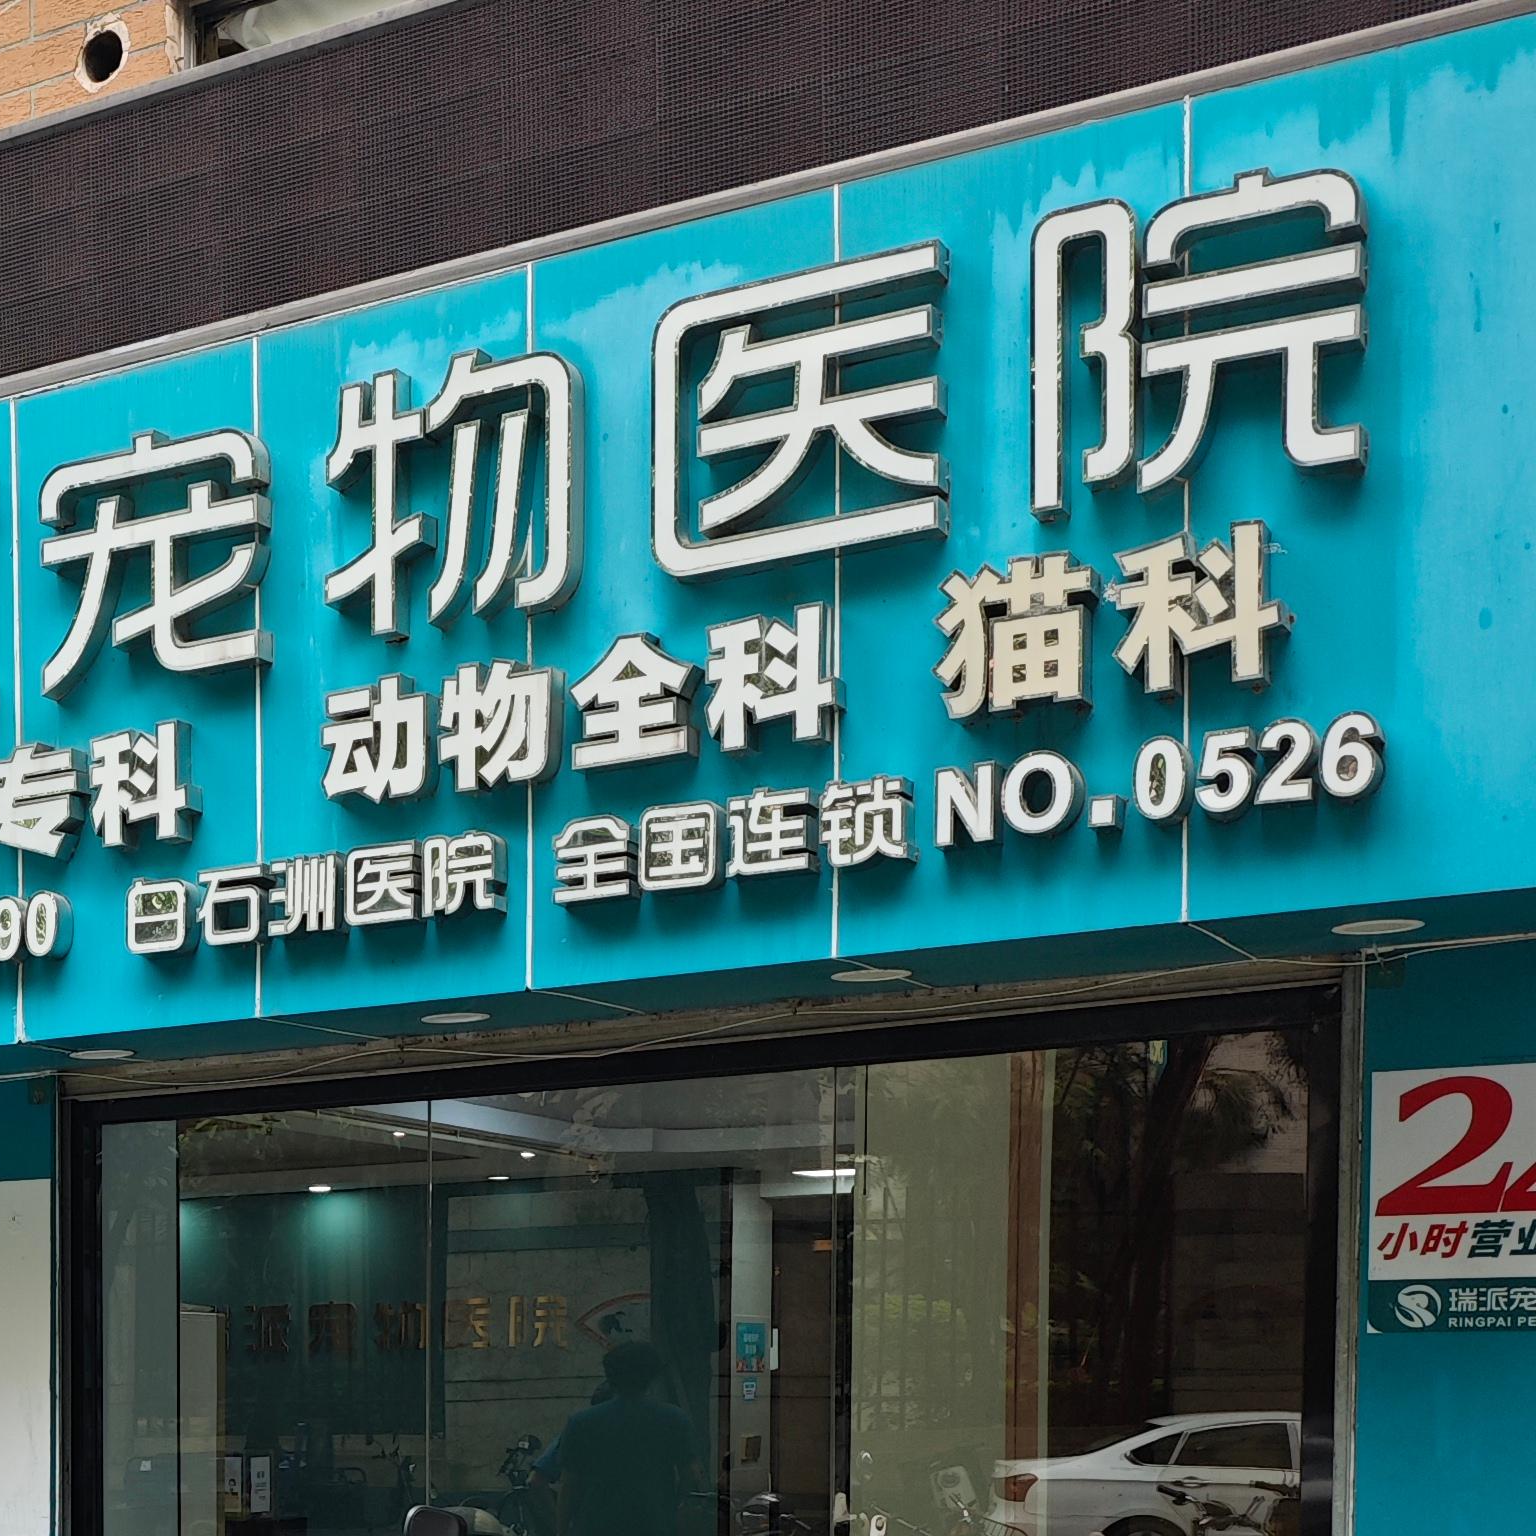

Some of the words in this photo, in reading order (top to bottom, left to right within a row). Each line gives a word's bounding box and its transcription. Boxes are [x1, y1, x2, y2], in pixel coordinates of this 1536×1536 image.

[321, 602, 845, 804] 动物全科
[931, 520, 1291, 722] 猫科
[126, 831, 507, 955] 白石洲医院
[552, 774, 919, 907] 全国连锁
[933, 710, 1386, 852] NO.0526
[1448, 1286, 1536, 1312] 瑞派宠
[1448, 1316, 1511, 1328] RINGPAI
